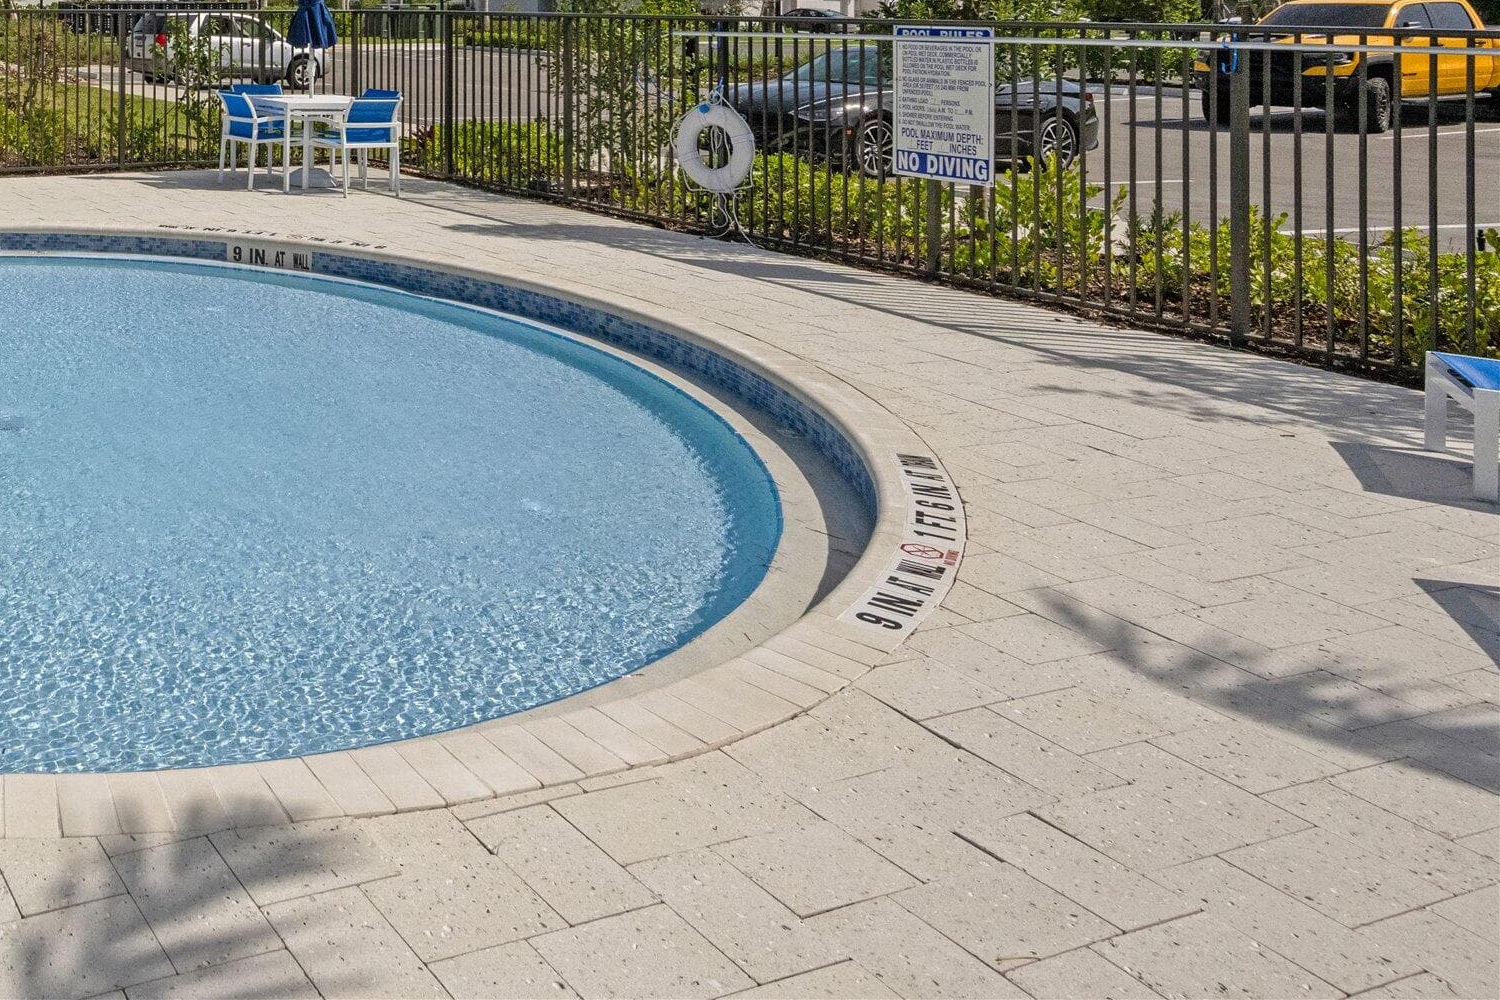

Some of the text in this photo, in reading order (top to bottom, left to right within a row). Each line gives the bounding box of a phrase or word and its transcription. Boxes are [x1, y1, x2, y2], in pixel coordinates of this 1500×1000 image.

[901, 127, 984, 145] POOL MAXIMUM DEPTH:
[916, 140, 934, 151] FEET
[949, 143, 977, 156] INCHES
[898, 150, 988, 181] NO DIVING
[233, 246, 310, 271] 9 IN. AT WALL
[904, 469, 946, 483] AT
[910, 482, 953, 500] IN.
[915, 499, 955, 511] 6
[915, 510, 957, 532] FT.
[913, 529, 956, 542] 1
[885, 575, 935, 597] AT
[867, 591, 925, 618] IN.
[855, 612, 903, 631] 9
